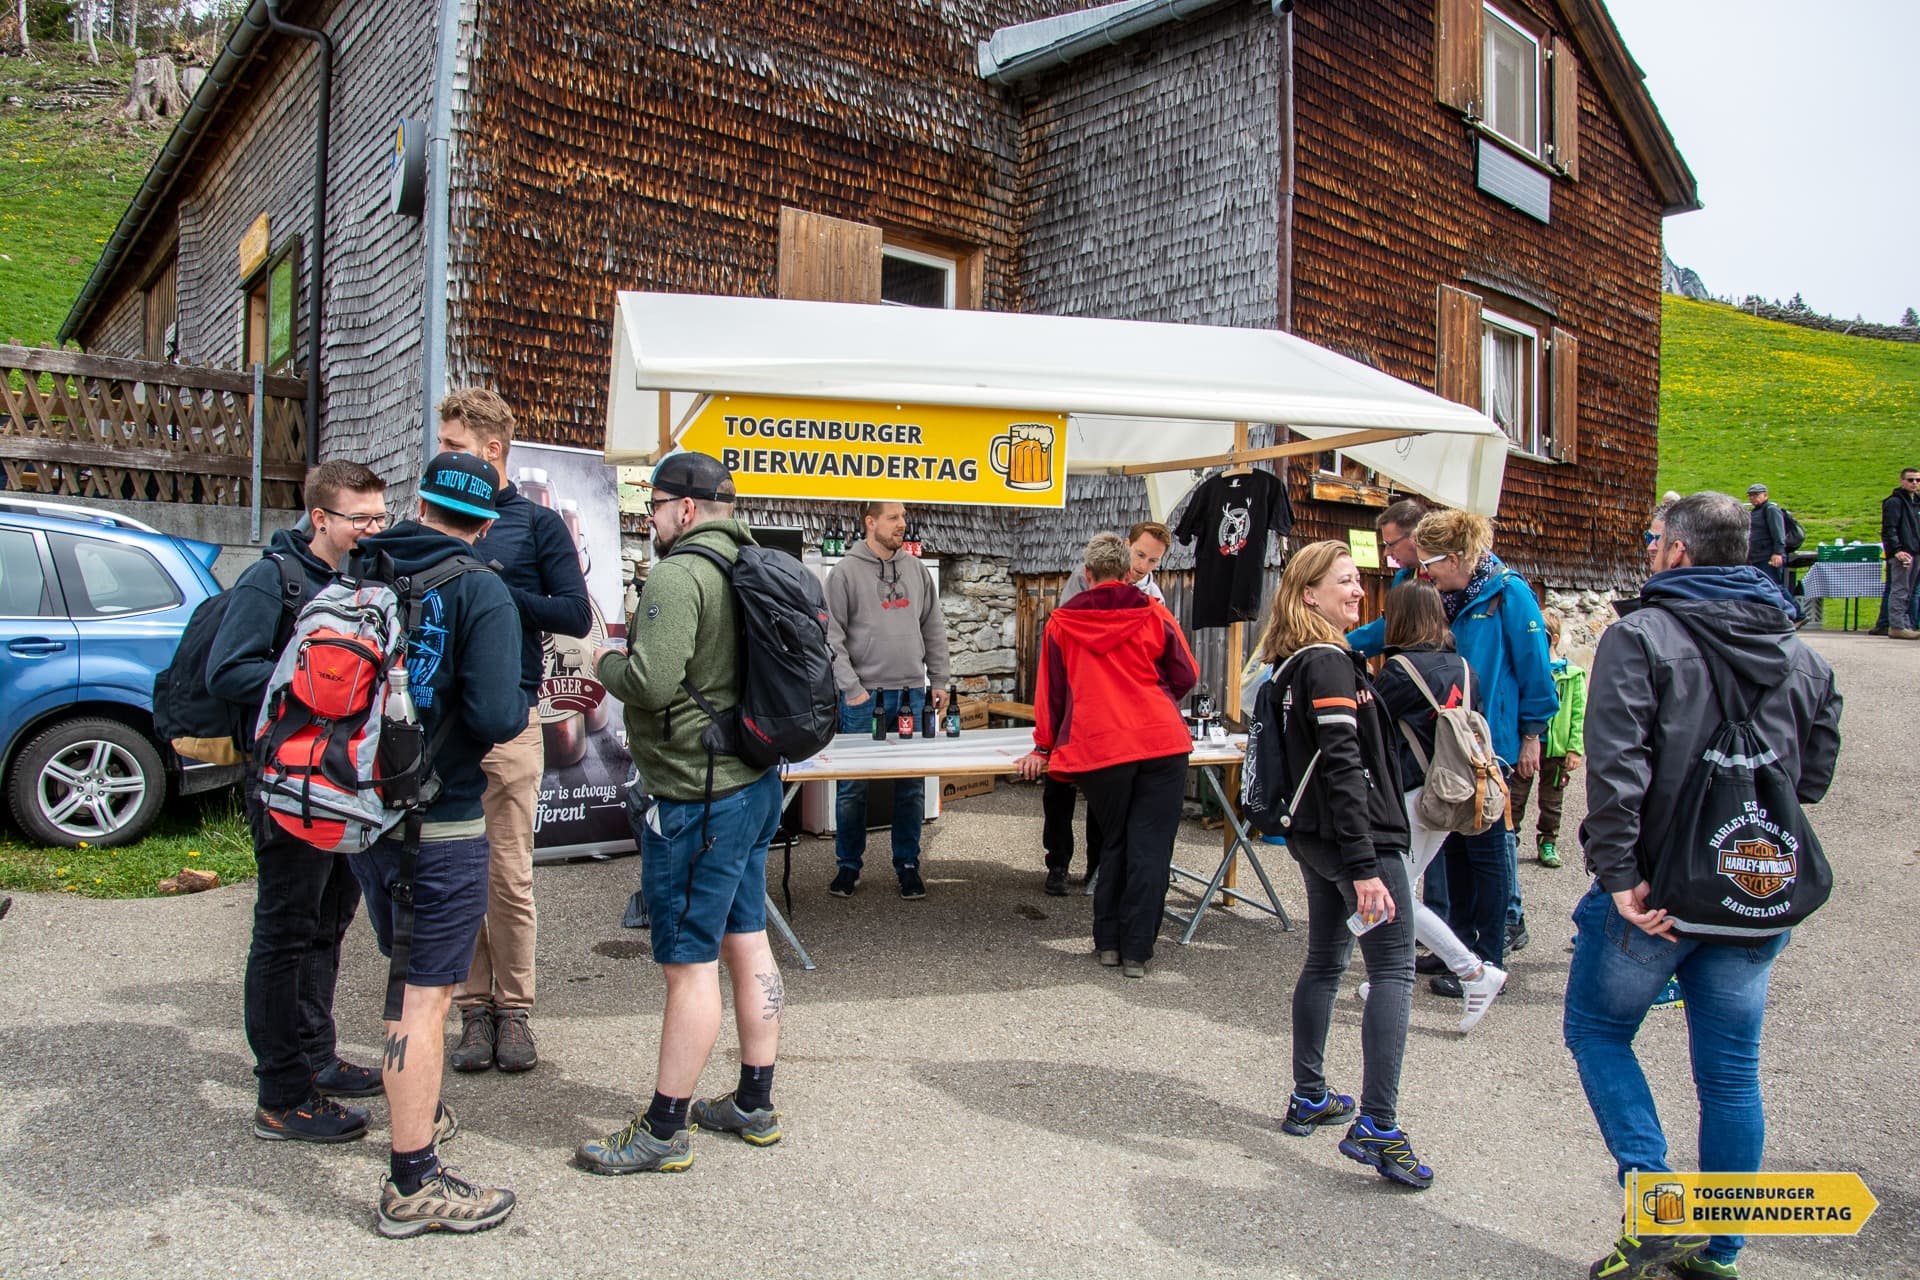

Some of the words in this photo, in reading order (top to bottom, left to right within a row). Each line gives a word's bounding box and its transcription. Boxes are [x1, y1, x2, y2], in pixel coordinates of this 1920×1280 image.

[724, 415, 923, 446] TOGGENBURGER
[723, 448, 977, 482] BIERWANDERTAG
[435, 469, 470, 491] KNOW
[467, 475, 493, 500] HOPE
[552, 679, 582, 695] DEER
[558, 786, 569, 800] is
[572, 783, 617, 803] always
[1721, 896, 1791, 917] BARCELONA
